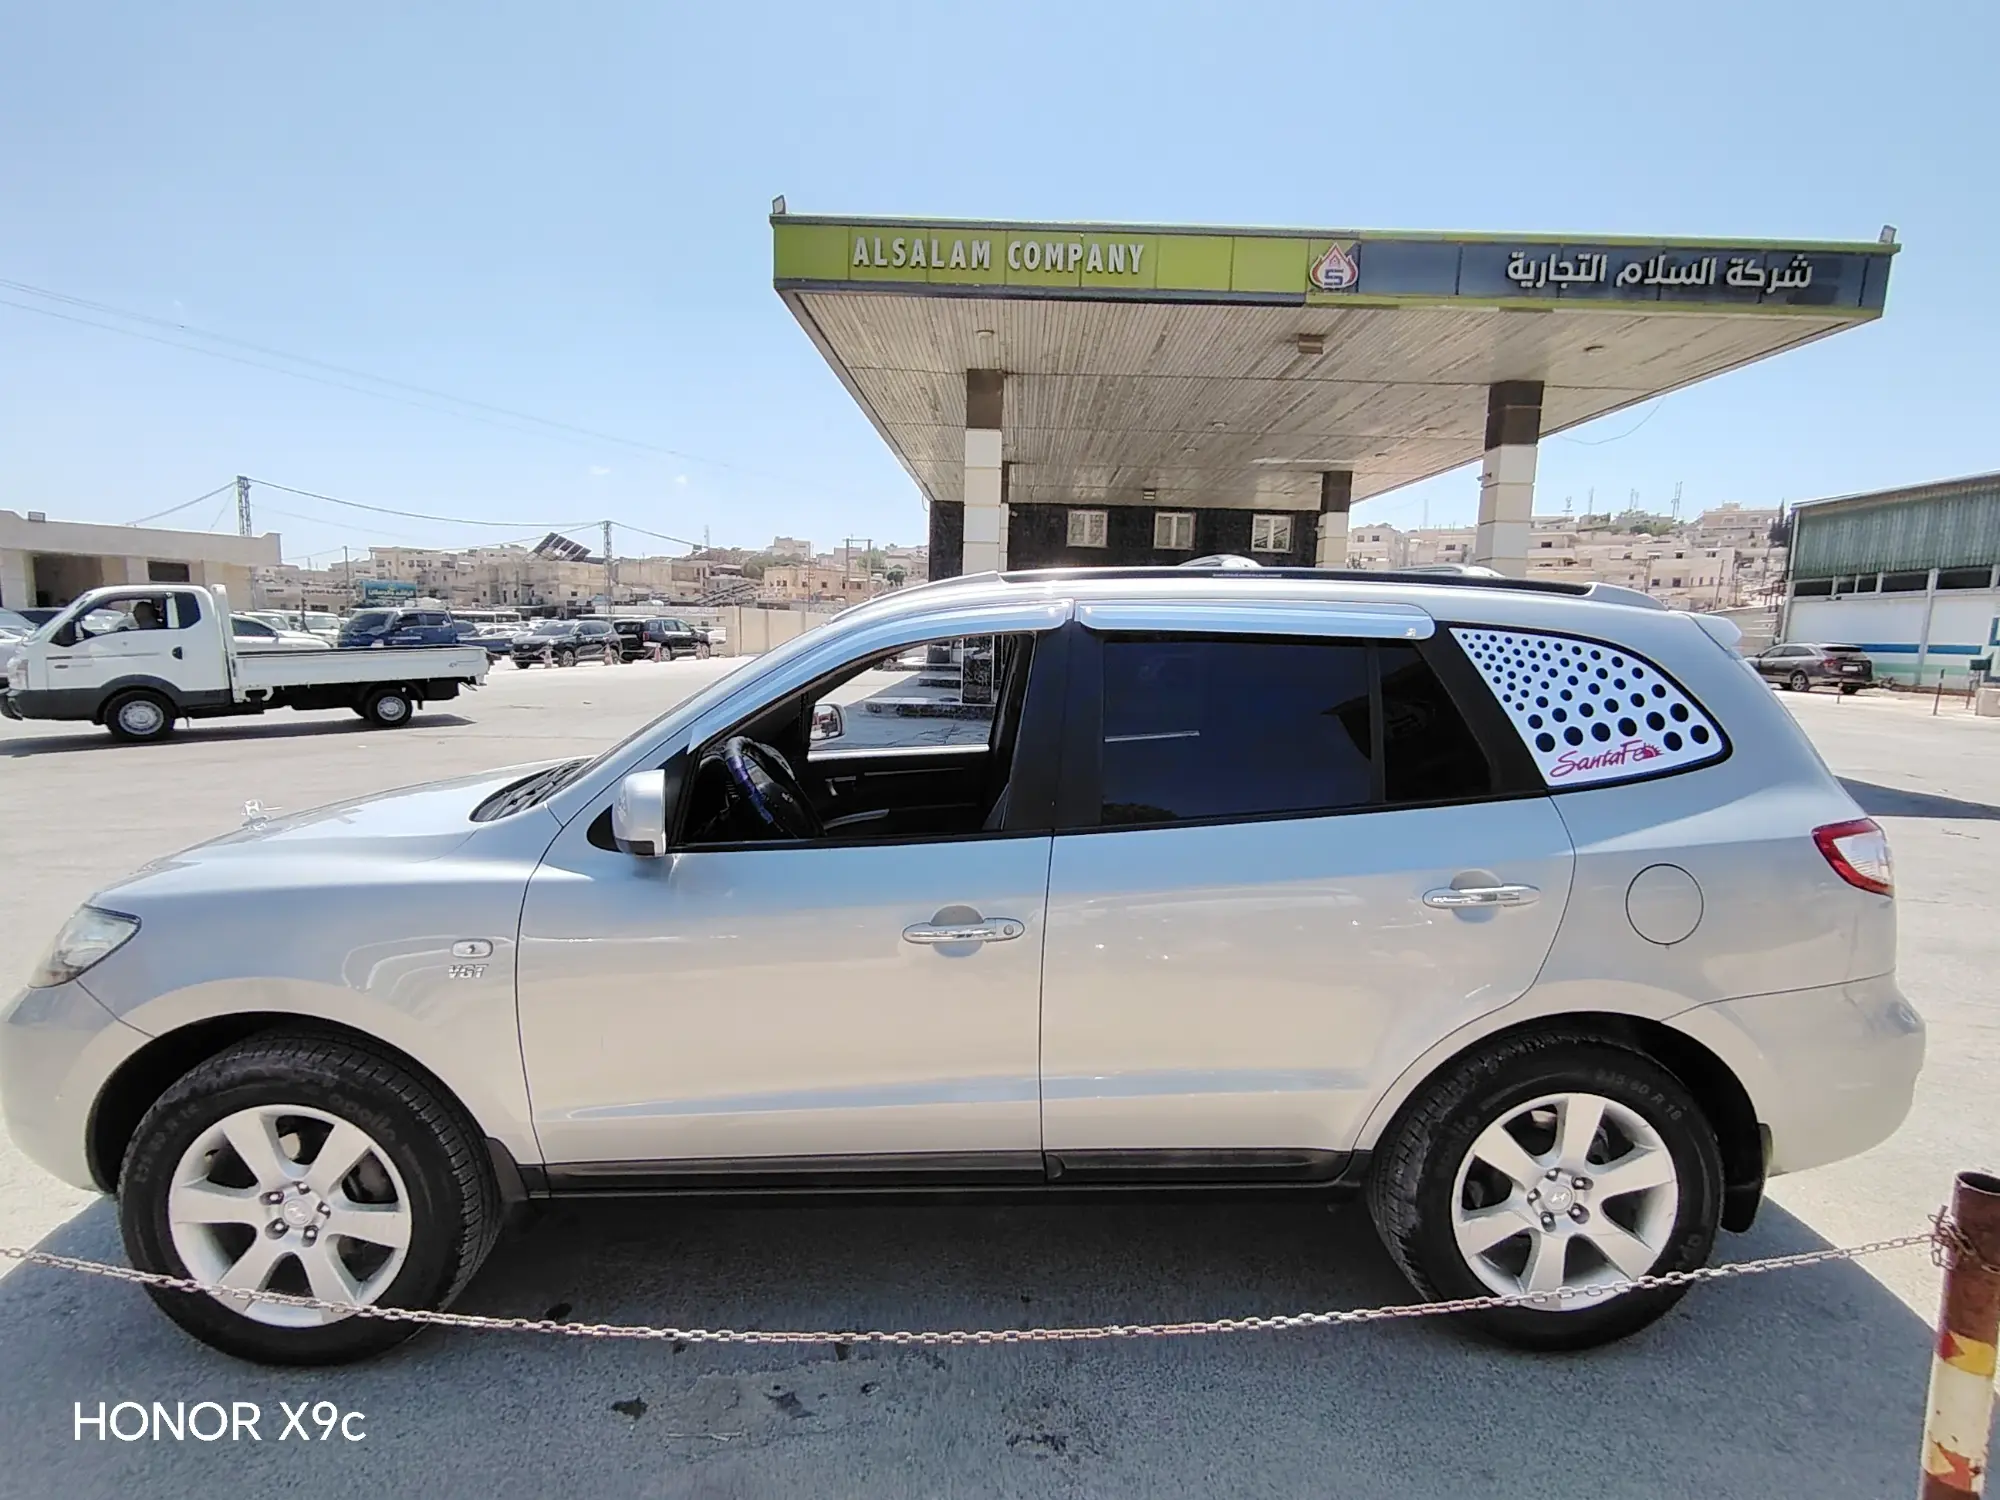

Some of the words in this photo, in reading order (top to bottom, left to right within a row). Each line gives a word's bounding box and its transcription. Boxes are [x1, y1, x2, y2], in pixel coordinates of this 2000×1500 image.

[853, 236, 991, 270] ALSALAM
[1007, 240, 1144, 274] COMPANY
[1507, 251, 1608, 289] التجارية
[1616, 255, 1717, 287] السلام
[1726, 254, 1813, 294] شركة
[448, 963, 489, 980] VGT
